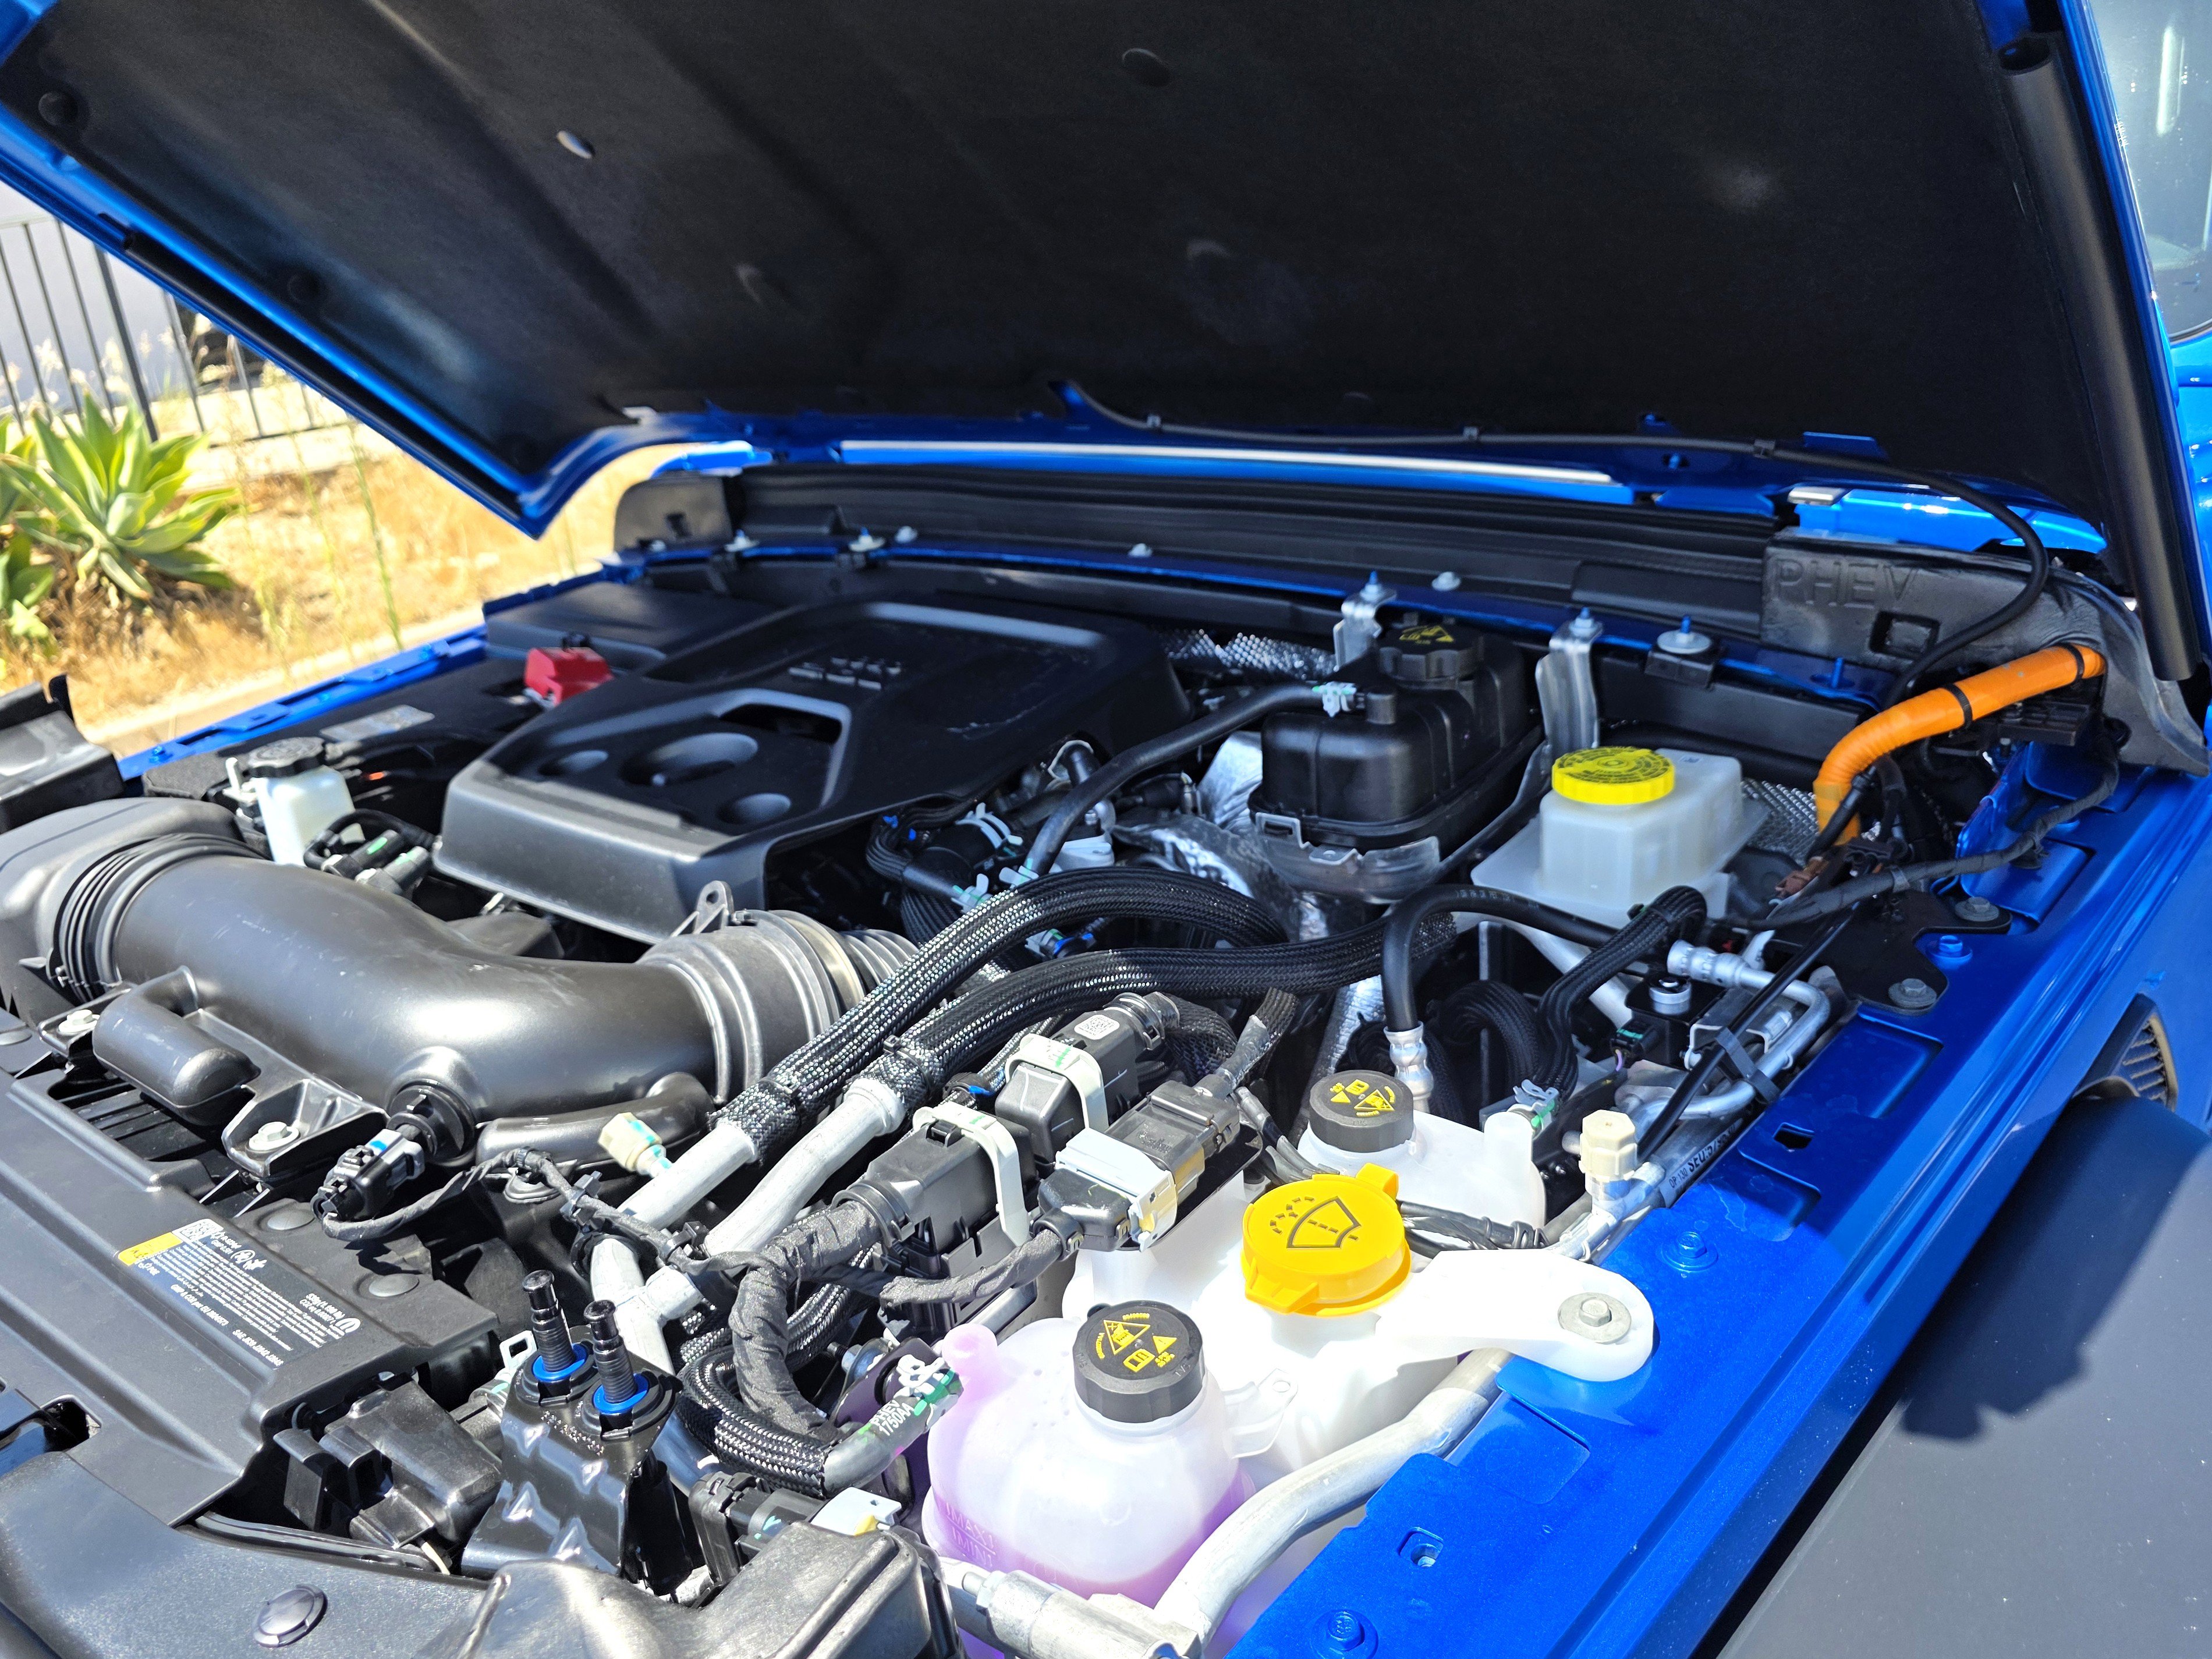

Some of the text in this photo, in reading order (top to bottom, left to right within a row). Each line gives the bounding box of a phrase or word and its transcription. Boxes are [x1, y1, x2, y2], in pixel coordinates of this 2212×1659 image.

[1775, 557, 1919, 609] PHEV
[870, 1399, 900, 1426] PHEV
[878, 1402, 914, 1436] 1750AA
